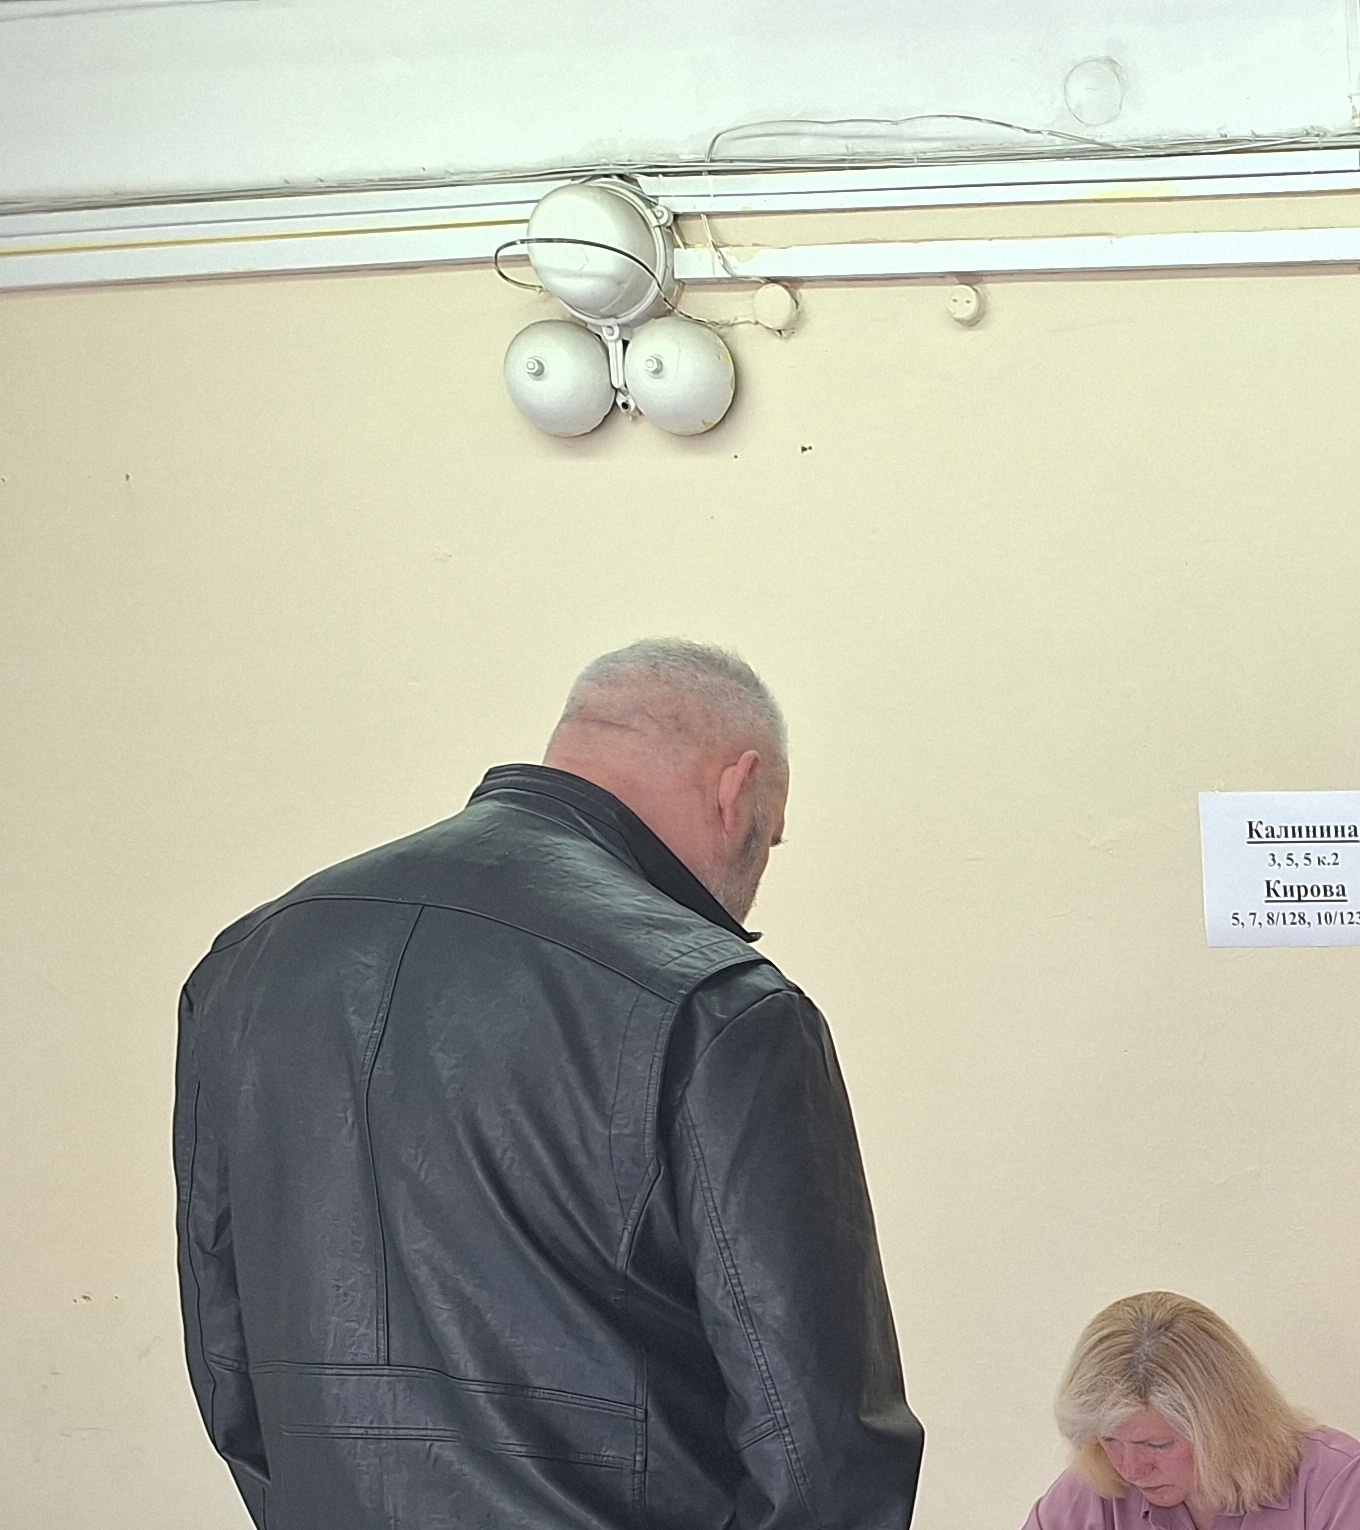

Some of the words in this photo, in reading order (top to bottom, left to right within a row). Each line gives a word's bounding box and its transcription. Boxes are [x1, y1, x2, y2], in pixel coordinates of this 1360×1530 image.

[1246, 820, 1359, 840] Калинина
[1267, 852, 1282, 869] 3,
[1285, 852, 1299, 869] 5,
[1303, 853, 1312, 867] 5
[1316, 852, 1340, 867] к.2
[1264, 879, 1347, 901] Кирова
[1231, 912, 1245, 929] 5,
[1248, 912, 1263, 929] 7,
[1266, 911, 1312, 928] 8/128,
